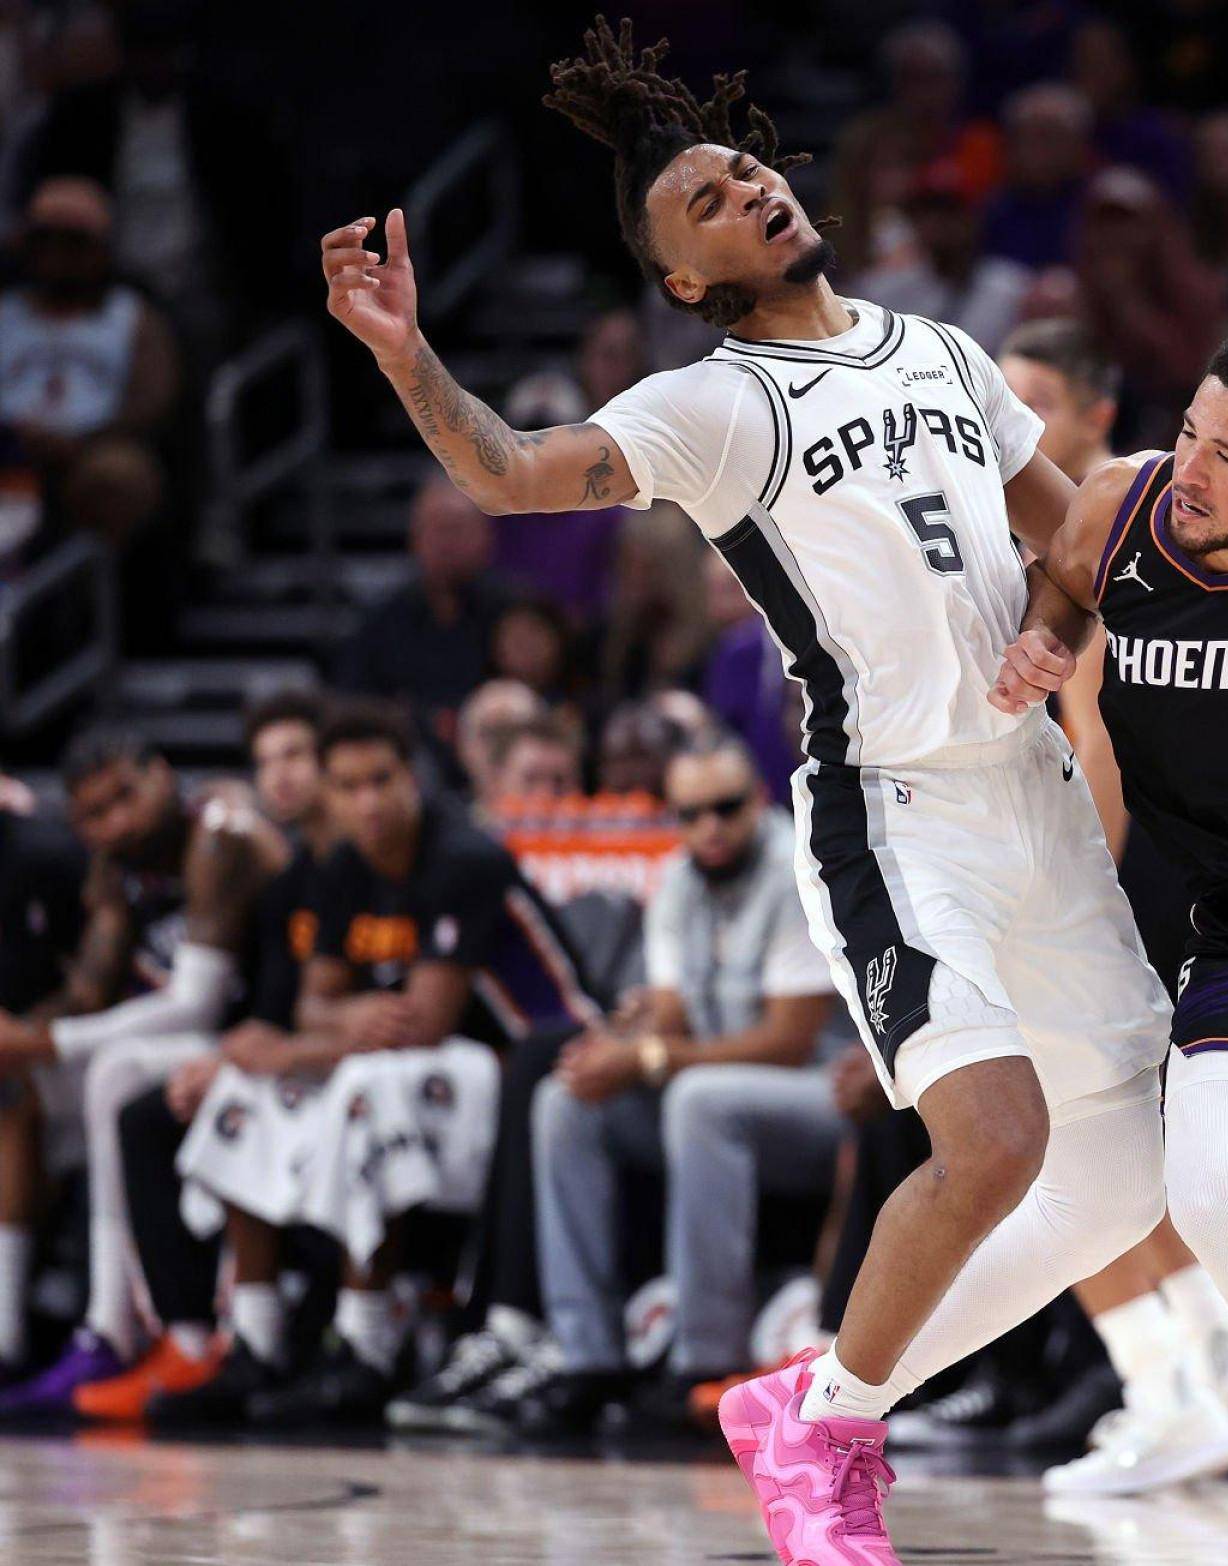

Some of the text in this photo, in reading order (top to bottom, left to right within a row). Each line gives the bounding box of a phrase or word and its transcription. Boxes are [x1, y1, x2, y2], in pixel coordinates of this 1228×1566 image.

[905, 370, 946, 382] LEDGER
[803, 403, 986, 496] SPURS
[897, 491, 965, 576] 5
